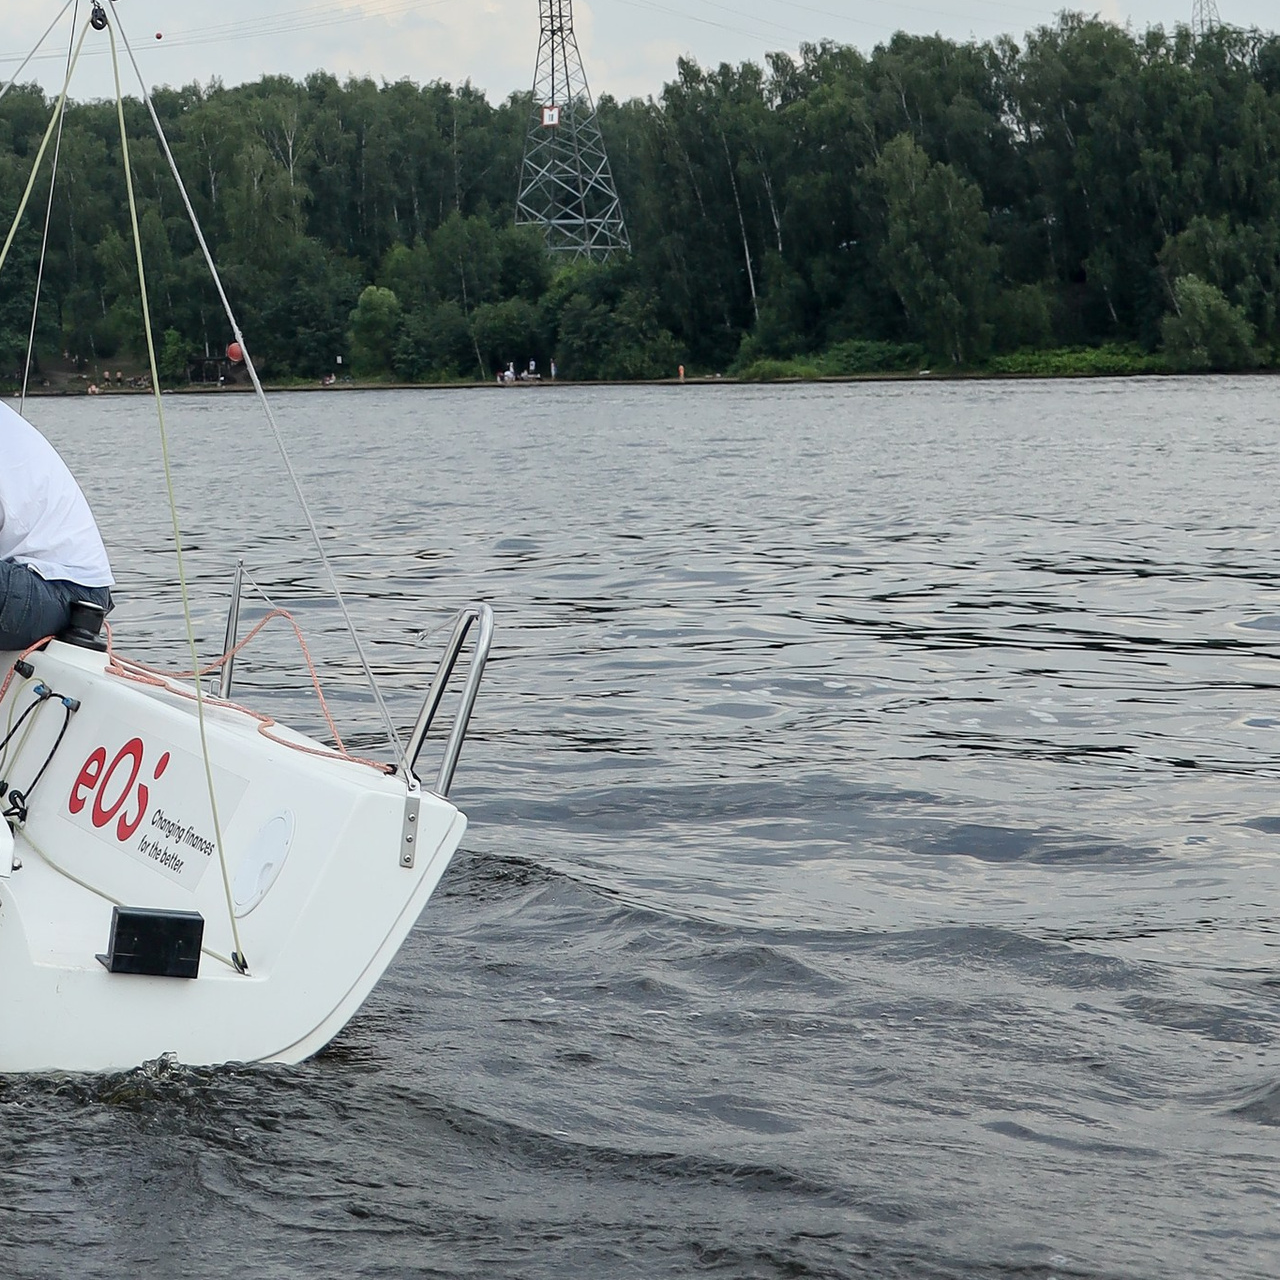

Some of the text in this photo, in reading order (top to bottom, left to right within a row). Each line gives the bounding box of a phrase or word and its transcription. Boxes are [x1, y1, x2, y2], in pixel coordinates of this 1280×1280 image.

[137, 834, 185, 874] for the better.
[151, 808, 215, 857] Changing finances
